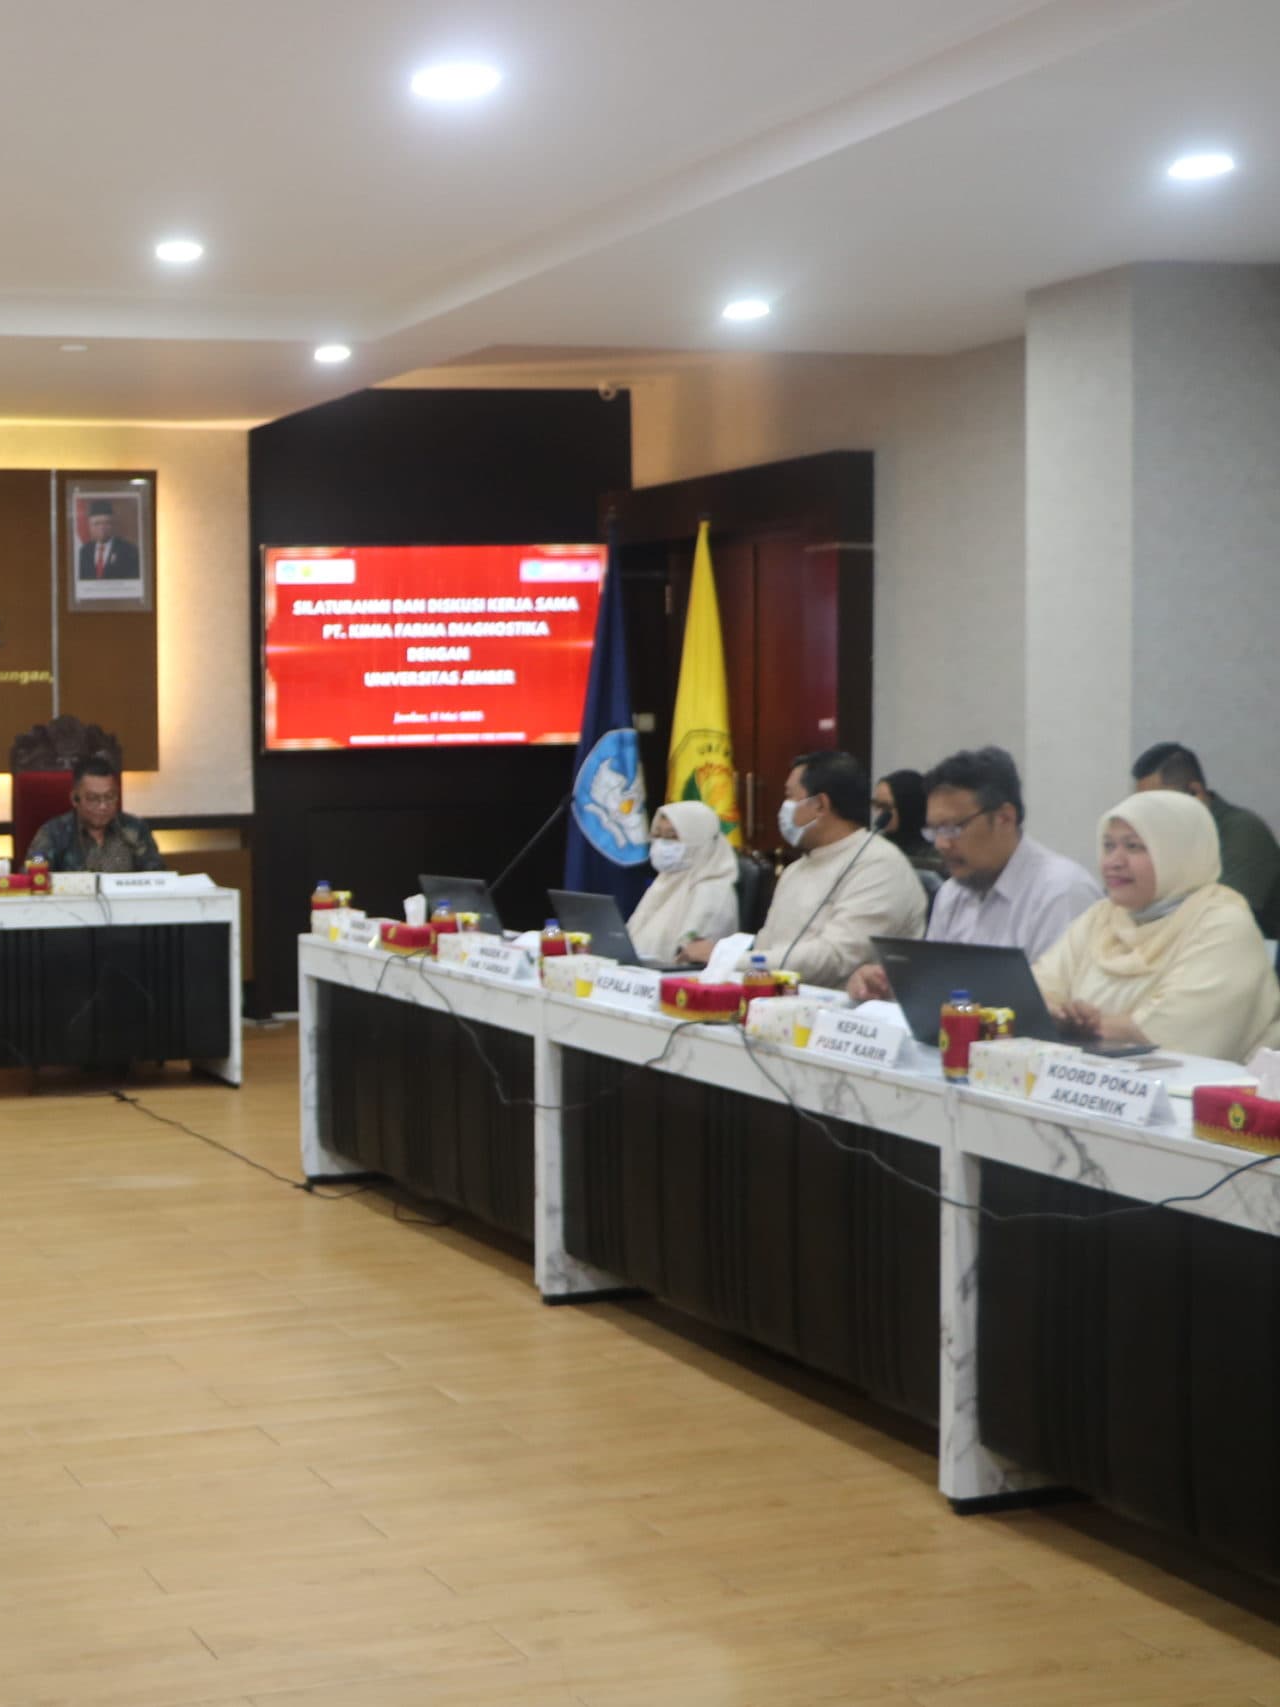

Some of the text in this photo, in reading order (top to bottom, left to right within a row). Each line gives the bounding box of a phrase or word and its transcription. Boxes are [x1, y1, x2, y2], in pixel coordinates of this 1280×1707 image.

[836, 1020, 880, 1040] KEPALA
[1046, 1063, 1150, 1099] KOORD POKJA
[1049, 1087, 1127, 1117] AKADEMIK
